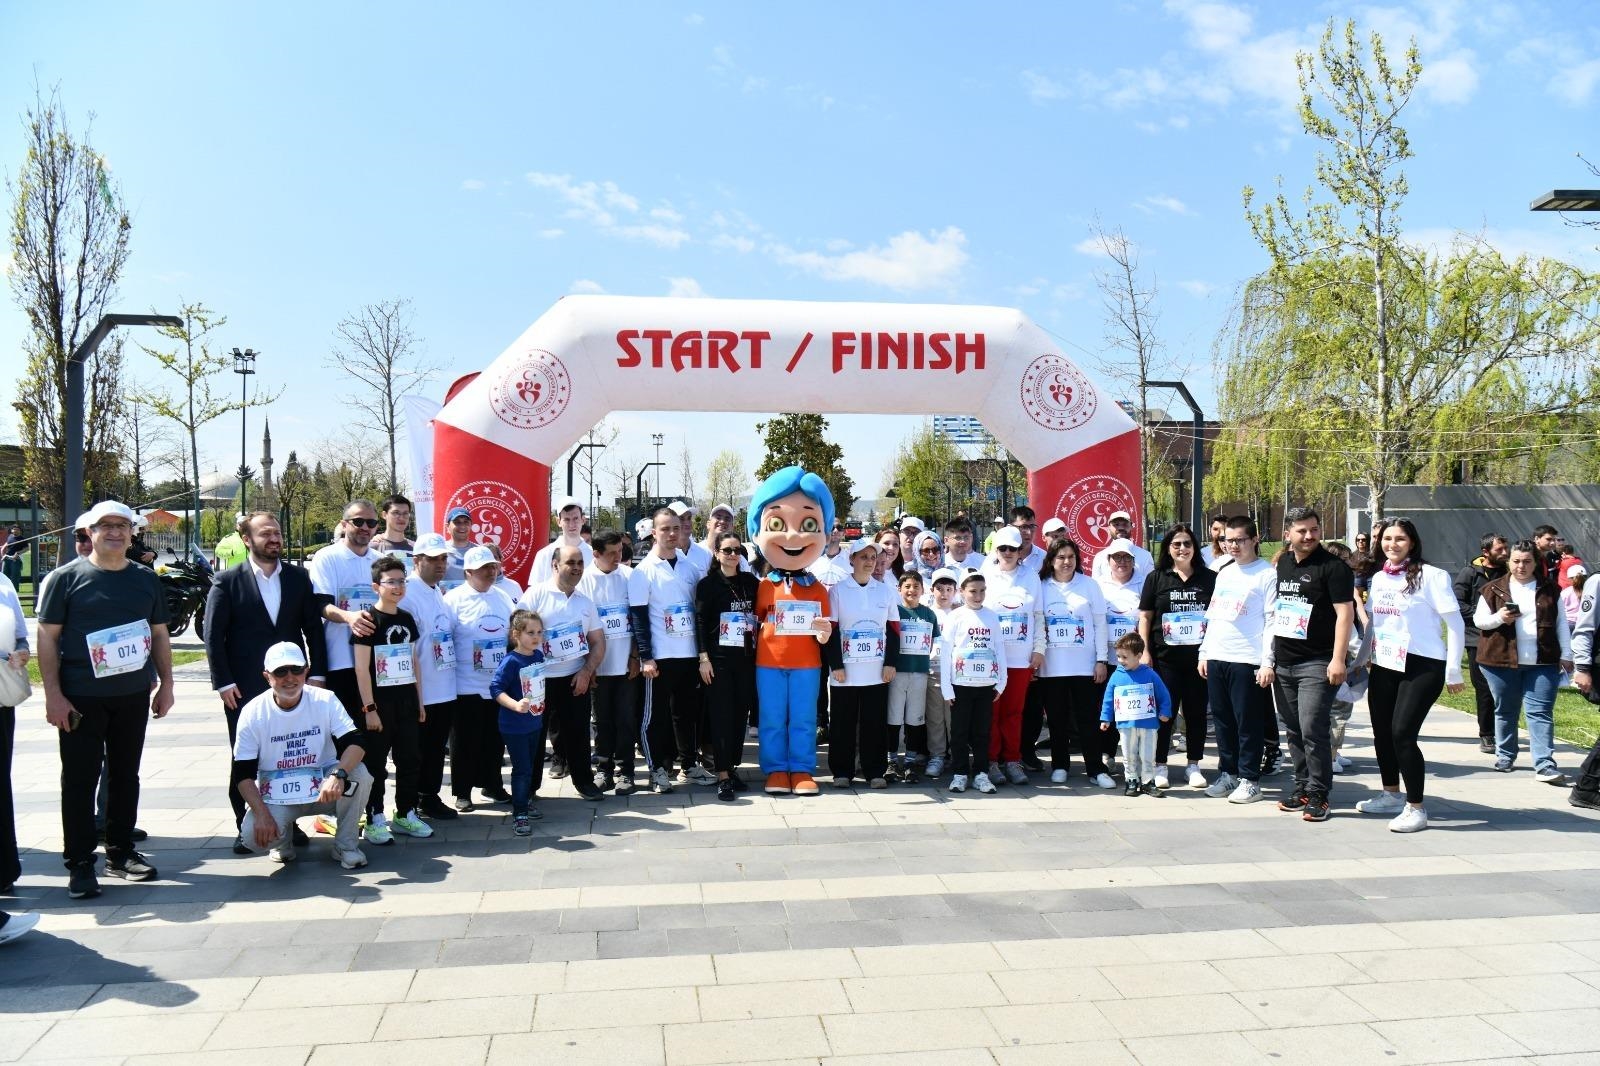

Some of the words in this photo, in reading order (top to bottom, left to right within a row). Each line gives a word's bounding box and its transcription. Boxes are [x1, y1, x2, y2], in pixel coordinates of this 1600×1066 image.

[616, 330, 771, 373] START
[785, 332, 814, 373] /
[832, 332, 985, 374] FINISH
[476, 498, 506, 509] GENÇLİK
[510, 514, 520, 532] SPOR
[1169, 589, 1196, 601] BİRLİKTE
[606, 618, 621, 629] 200
[793, 615, 805, 624] 135
[1278, 615, 1290, 626] 213
[1002, 626, 1014, 636] 191
[1055, 627, 1069, 637] 181
[1114, 627, 1127, 637] 182
[1179, 626, 1193, 635] 207
[559, 638, 574, 651] 195
[905, 635, 917, 644] 177
[117, 643, 138, 659] 074
[857, 642, 871, 652] 205
[397, 660, 410, 671] 152
[972, 663, 985, 672] 166
[1127, 699, 1142, 710] 222
[286, 738, 306, 750] VARIZ
[283, 747, 309, 758] BİRLİKTE
[282, 781, 301, 794] 075
